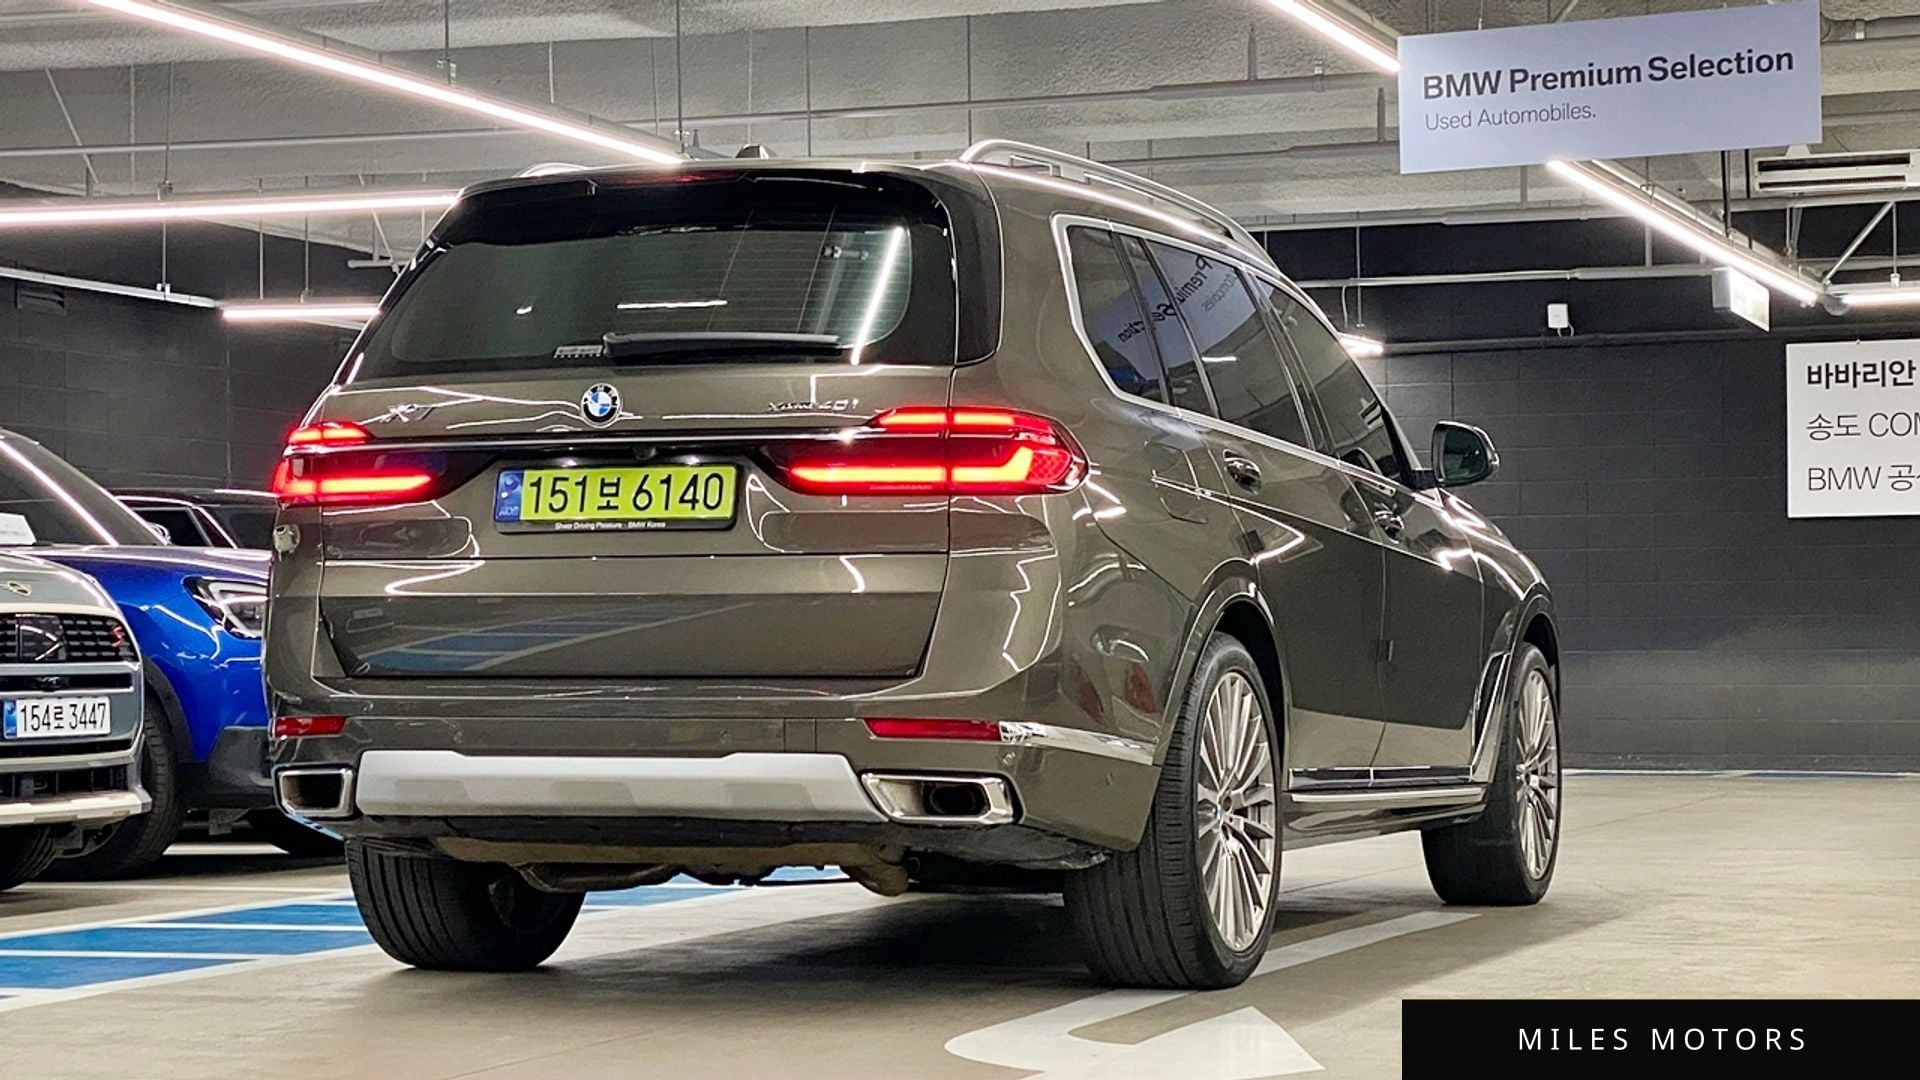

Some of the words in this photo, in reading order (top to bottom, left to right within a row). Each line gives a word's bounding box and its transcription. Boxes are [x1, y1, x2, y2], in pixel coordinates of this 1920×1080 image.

[1422, 69, 1502, 100] BMW
[1509, 63, 1642, 93] Premium
[1648, 48, 1795, 82] Selection
[1424, 111, 1472, 132] Used
[1477, 103, 1597, 127] Automobiles.
[1807, 360, 1917, 390] 바바리안
[1806, 413, 1861, 441] 송도
[1808, 466, 1882, 491] BMW
[1888, 464, 1920, 491] 공
[529, 475, 621, 513] 151보
[632, 472, 724, 512] 6140
[574, 522, 595, 531] Driving
[69, 702, 106, 730] 3447
